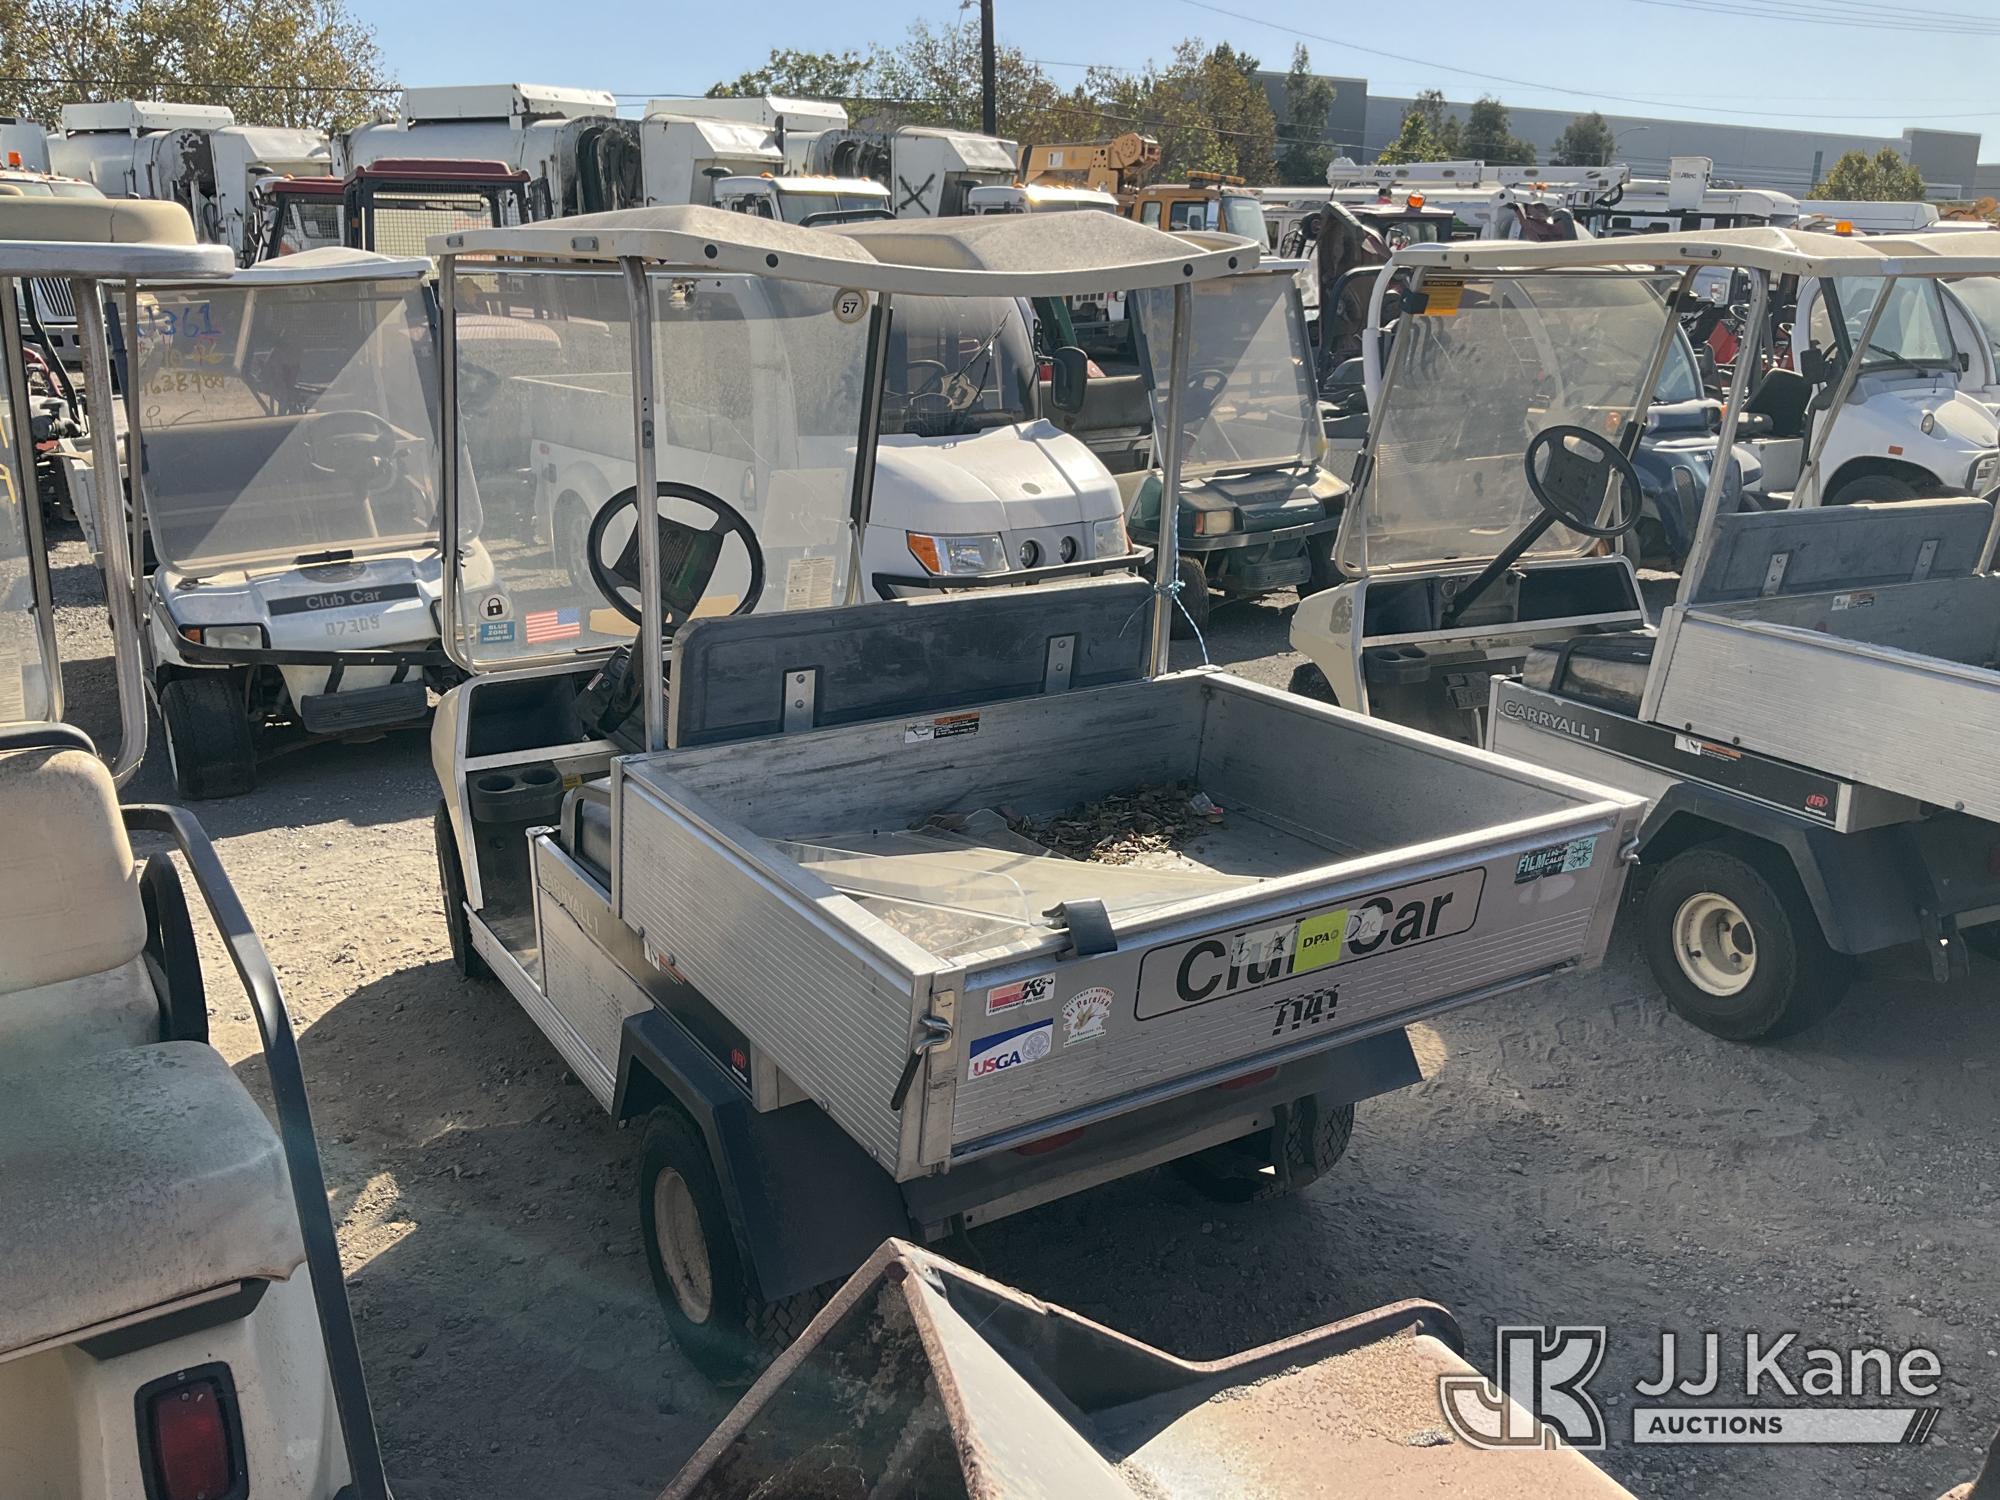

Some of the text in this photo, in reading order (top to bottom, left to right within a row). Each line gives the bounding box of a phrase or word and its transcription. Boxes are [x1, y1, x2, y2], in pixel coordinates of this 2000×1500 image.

[842, 301, 858, 314] 57
[305, 590, 381, 609] Club Car
[1504, 700, 1590, 739] CARRYALL
[1517, 852, 1548, 875] FILM
[542, 864, 593, 930] CARRYALL
[1347, 891, 1453, 955] Car
[1302, 931, 1331, 949] DPA
[1021, 977, 1054, 1000] K&N
[973, 1050, 1021, 1077] USGA
